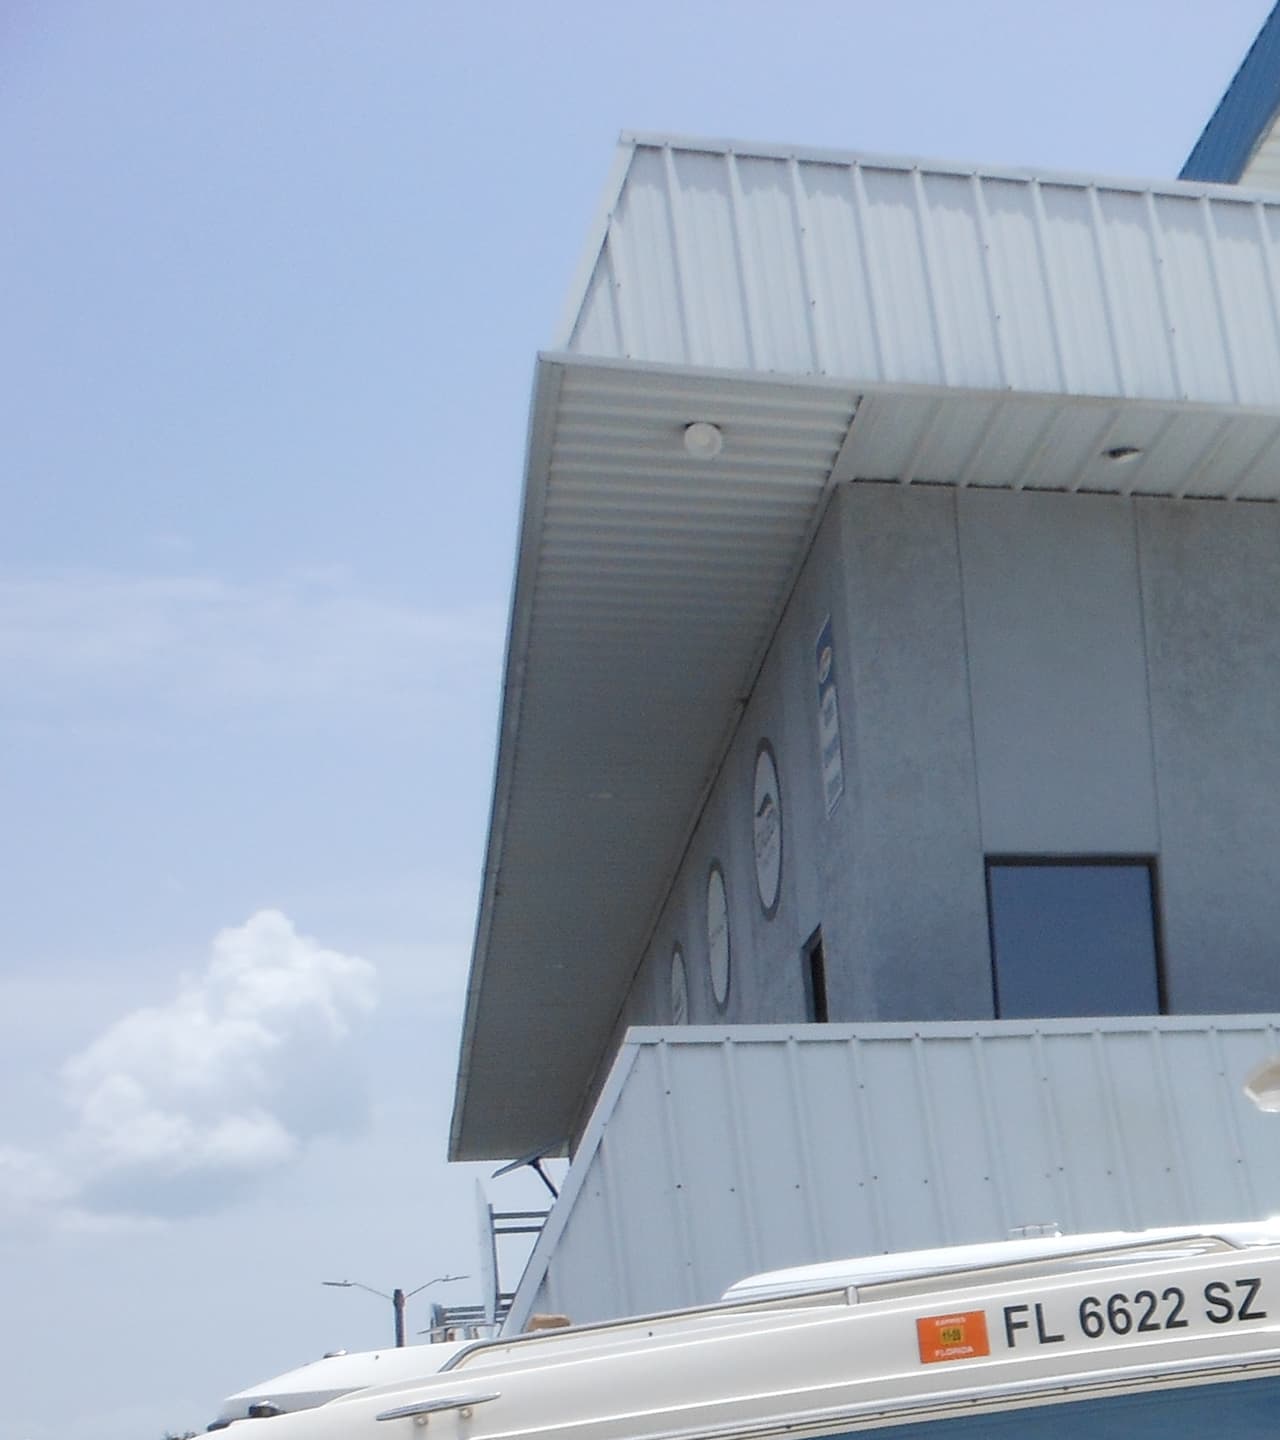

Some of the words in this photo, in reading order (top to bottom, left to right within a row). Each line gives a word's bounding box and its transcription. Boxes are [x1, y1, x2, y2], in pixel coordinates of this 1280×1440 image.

[1003, 1302, 1066, 1348] FL
[1078, 1286, 1189, 1339] 6622
[1203, 1278, 1268, 1324] SZ
